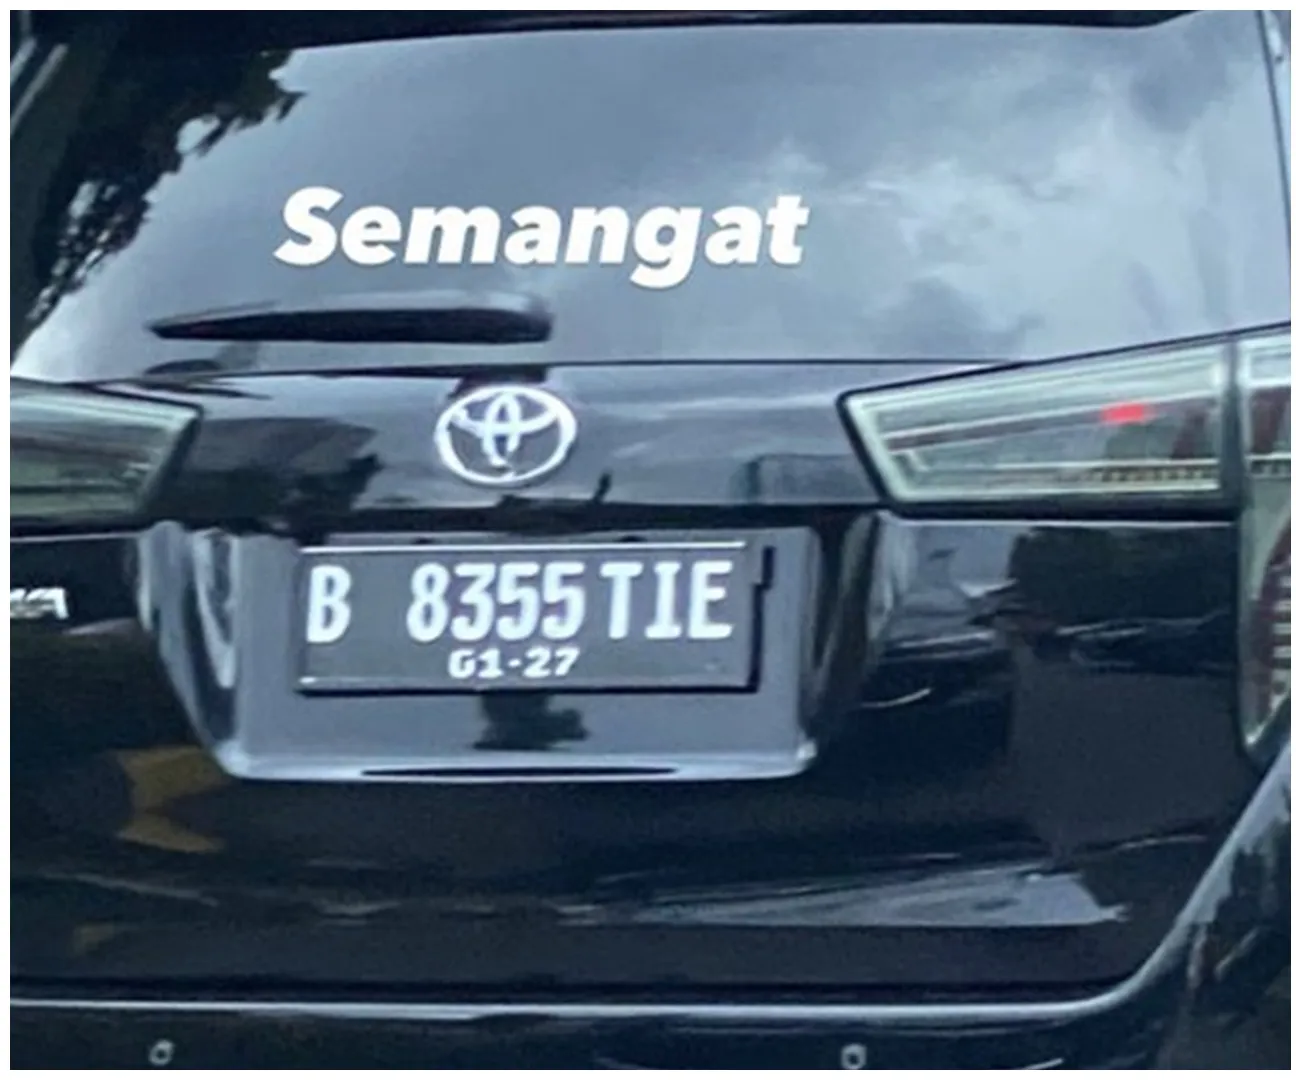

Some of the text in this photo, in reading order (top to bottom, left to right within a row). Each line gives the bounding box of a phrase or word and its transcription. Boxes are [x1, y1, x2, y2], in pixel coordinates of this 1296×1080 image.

[305, 559, 734, 643] B 8355 TIE
